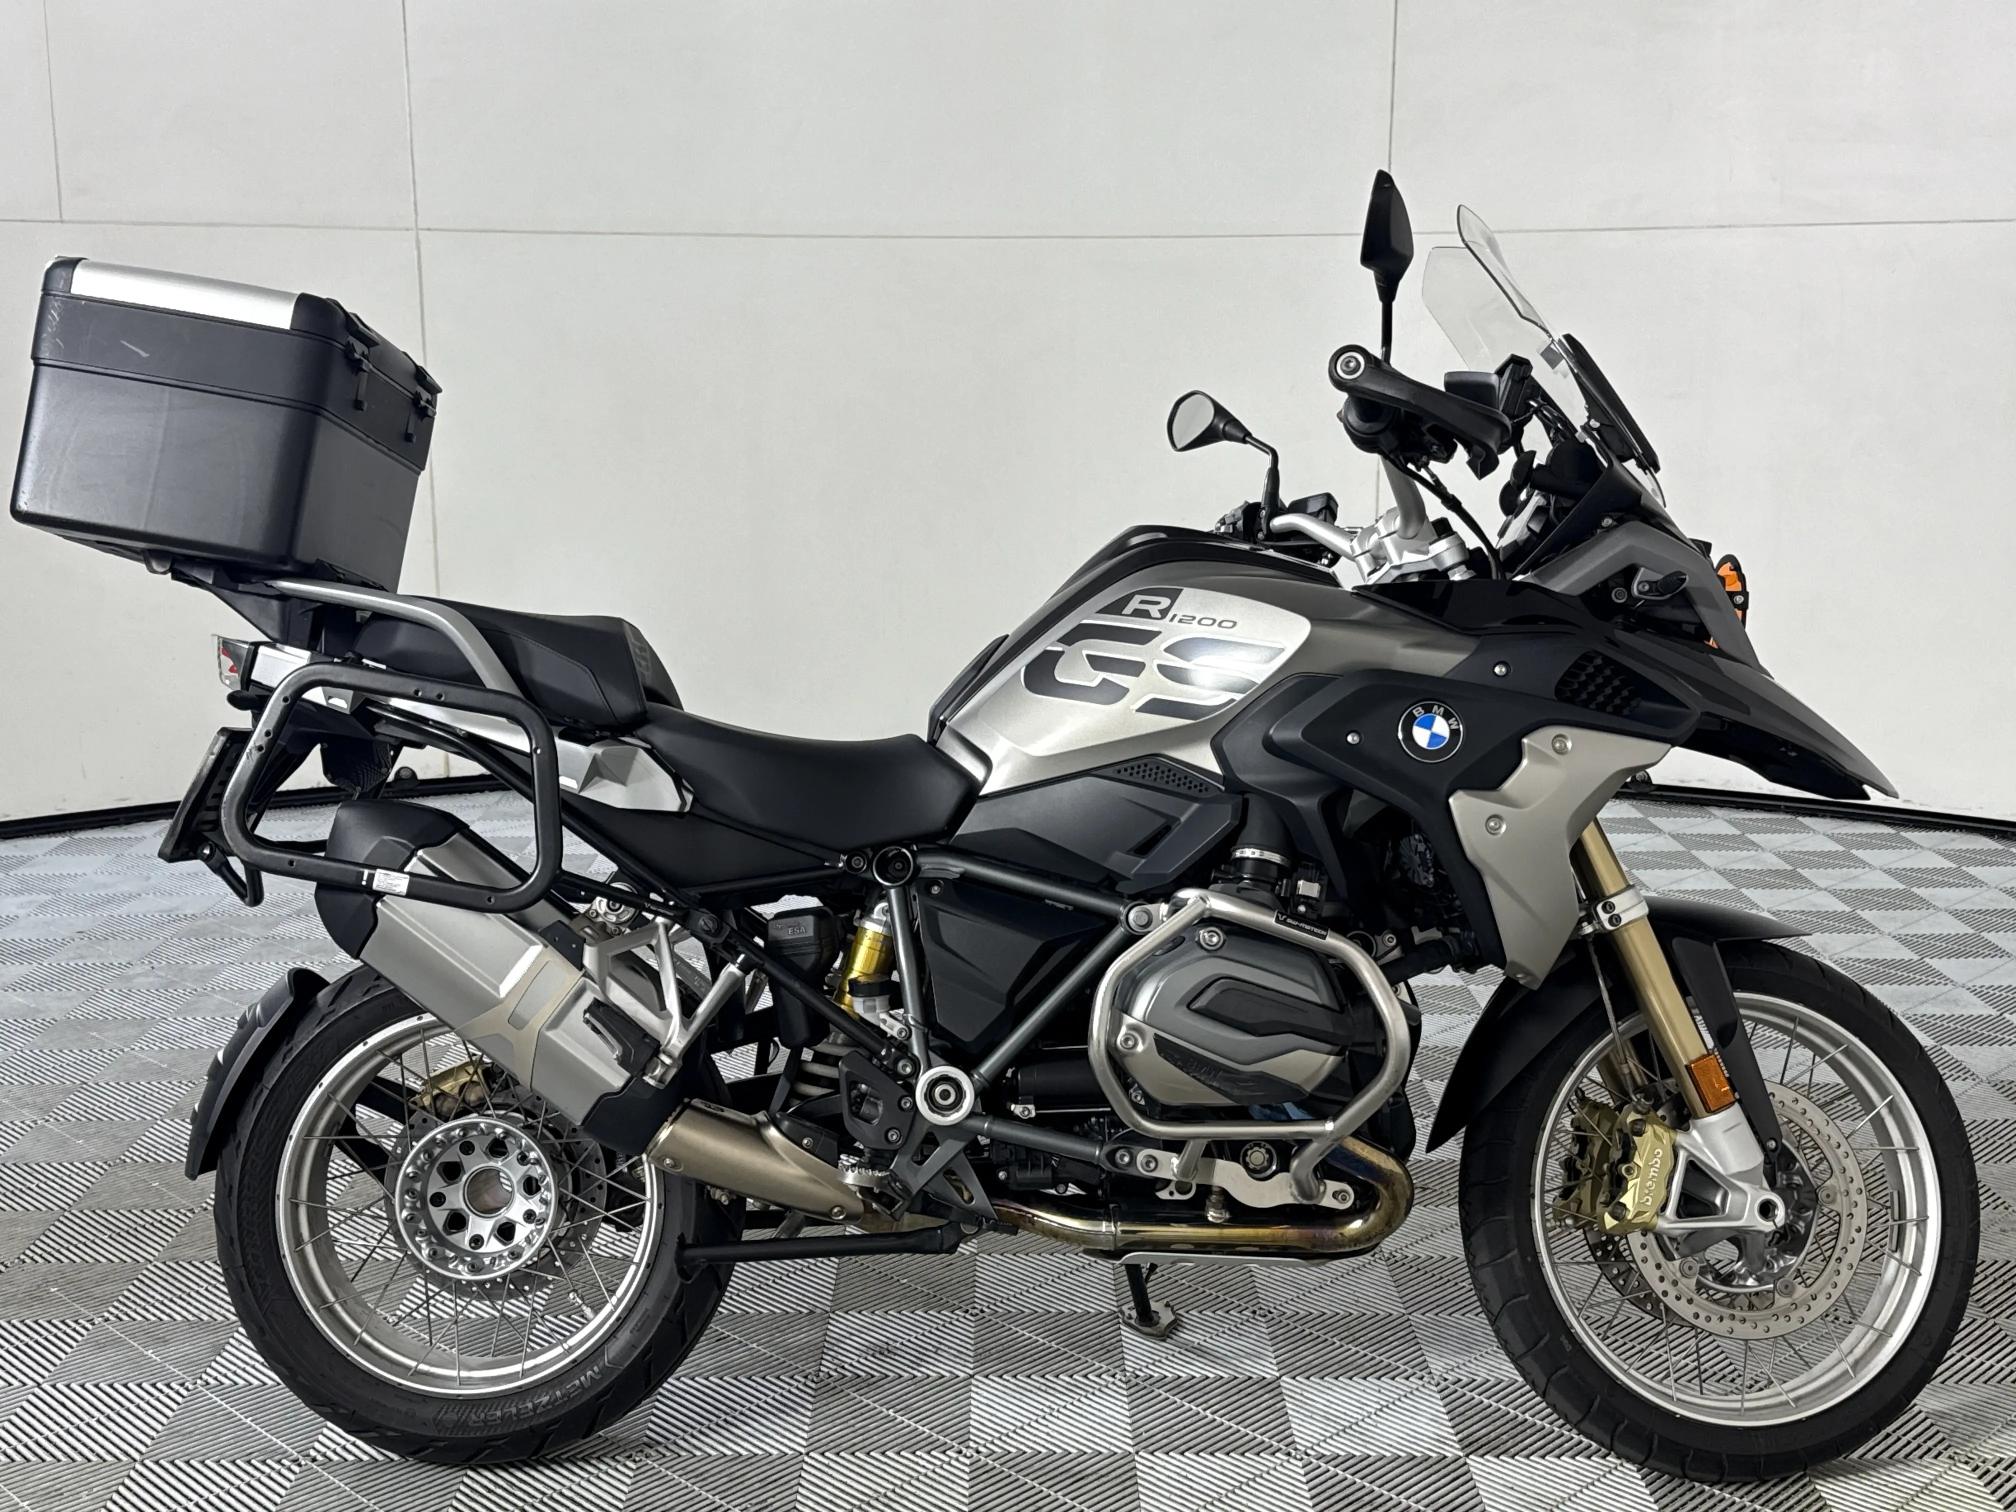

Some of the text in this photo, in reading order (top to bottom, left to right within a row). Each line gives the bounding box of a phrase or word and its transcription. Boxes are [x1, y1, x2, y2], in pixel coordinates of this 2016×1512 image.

[1021, 620, 1286, 722] GS
[1413, 705, 1460, 730] BMW
[1641, 1149, 1663, 1206] brembo
[470, 1365, 602, 1426] METZELER
